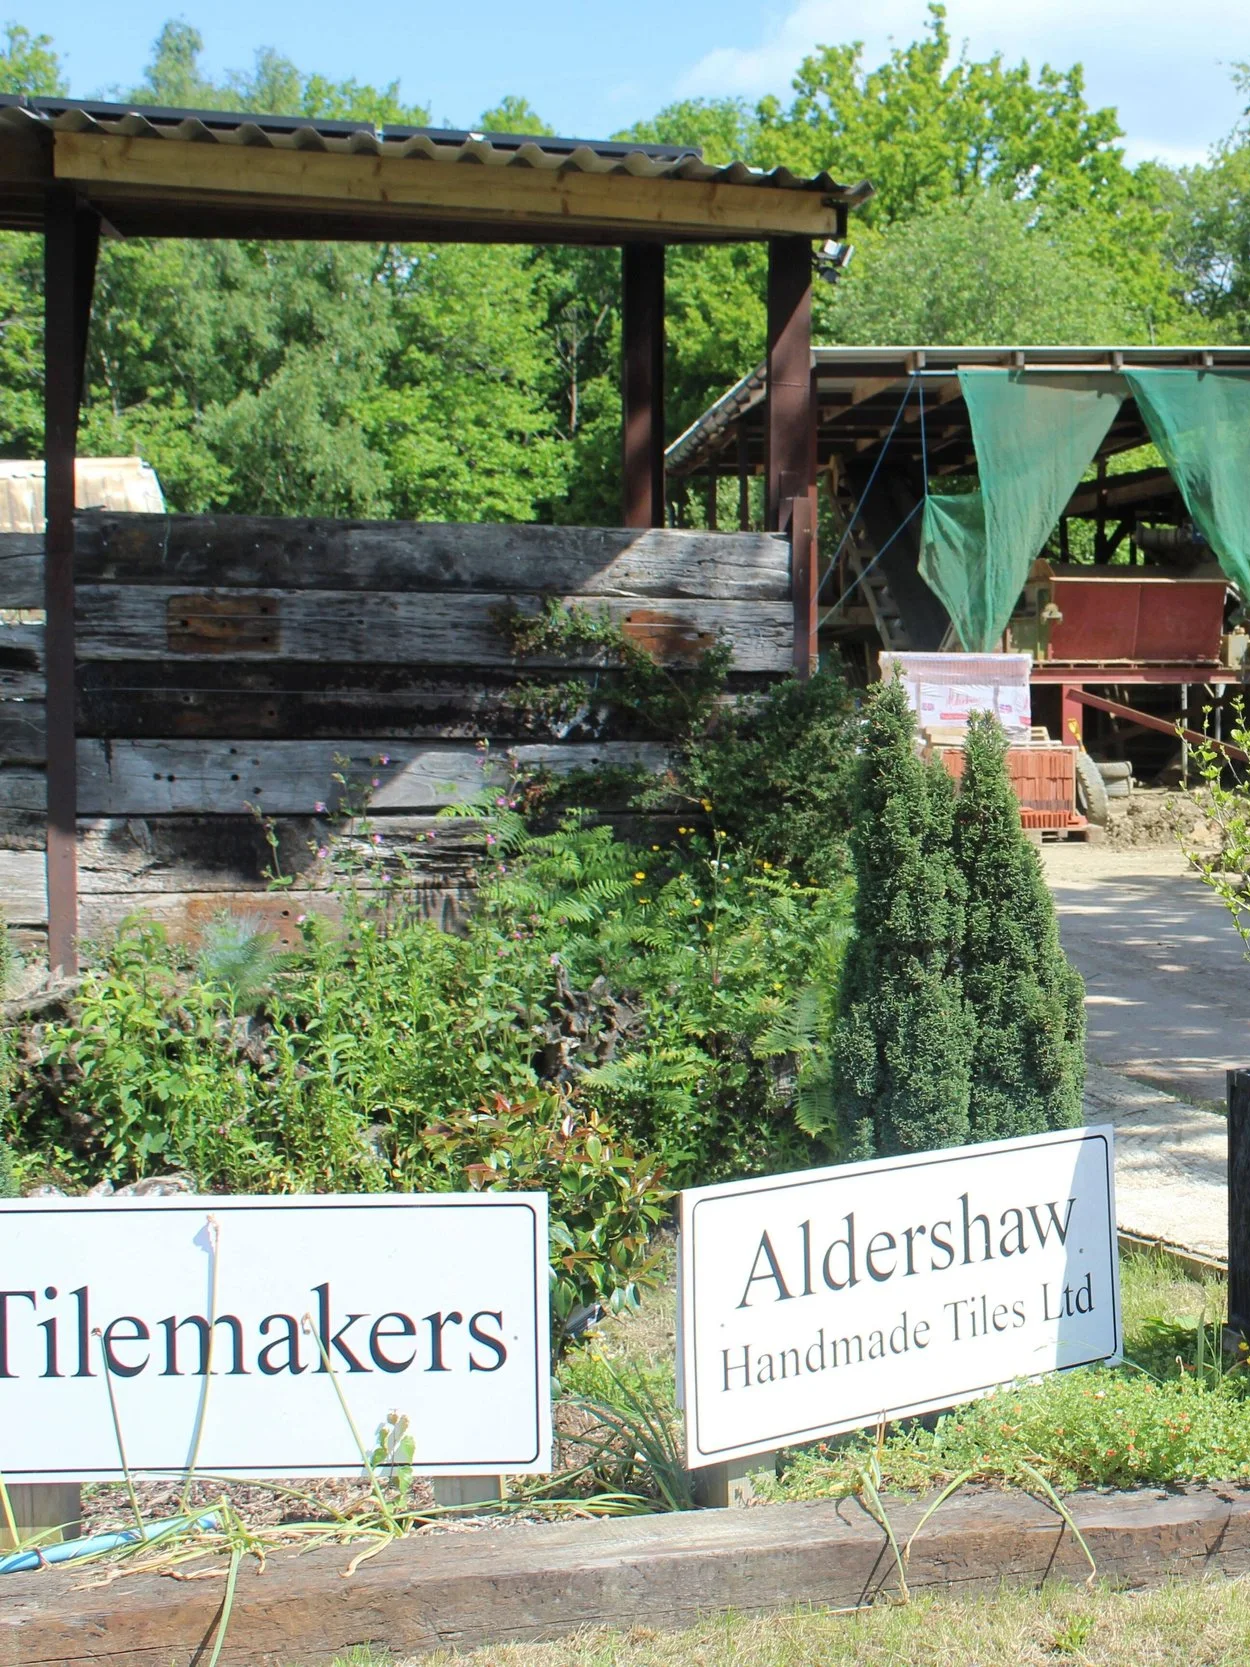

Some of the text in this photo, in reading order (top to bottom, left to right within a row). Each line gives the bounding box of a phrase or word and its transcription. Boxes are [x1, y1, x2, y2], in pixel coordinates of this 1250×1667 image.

[735, 1192, 1077, 1309] Aldershaw
[720, 1272, 1095, 1392] Handmade Tiles Ltd
